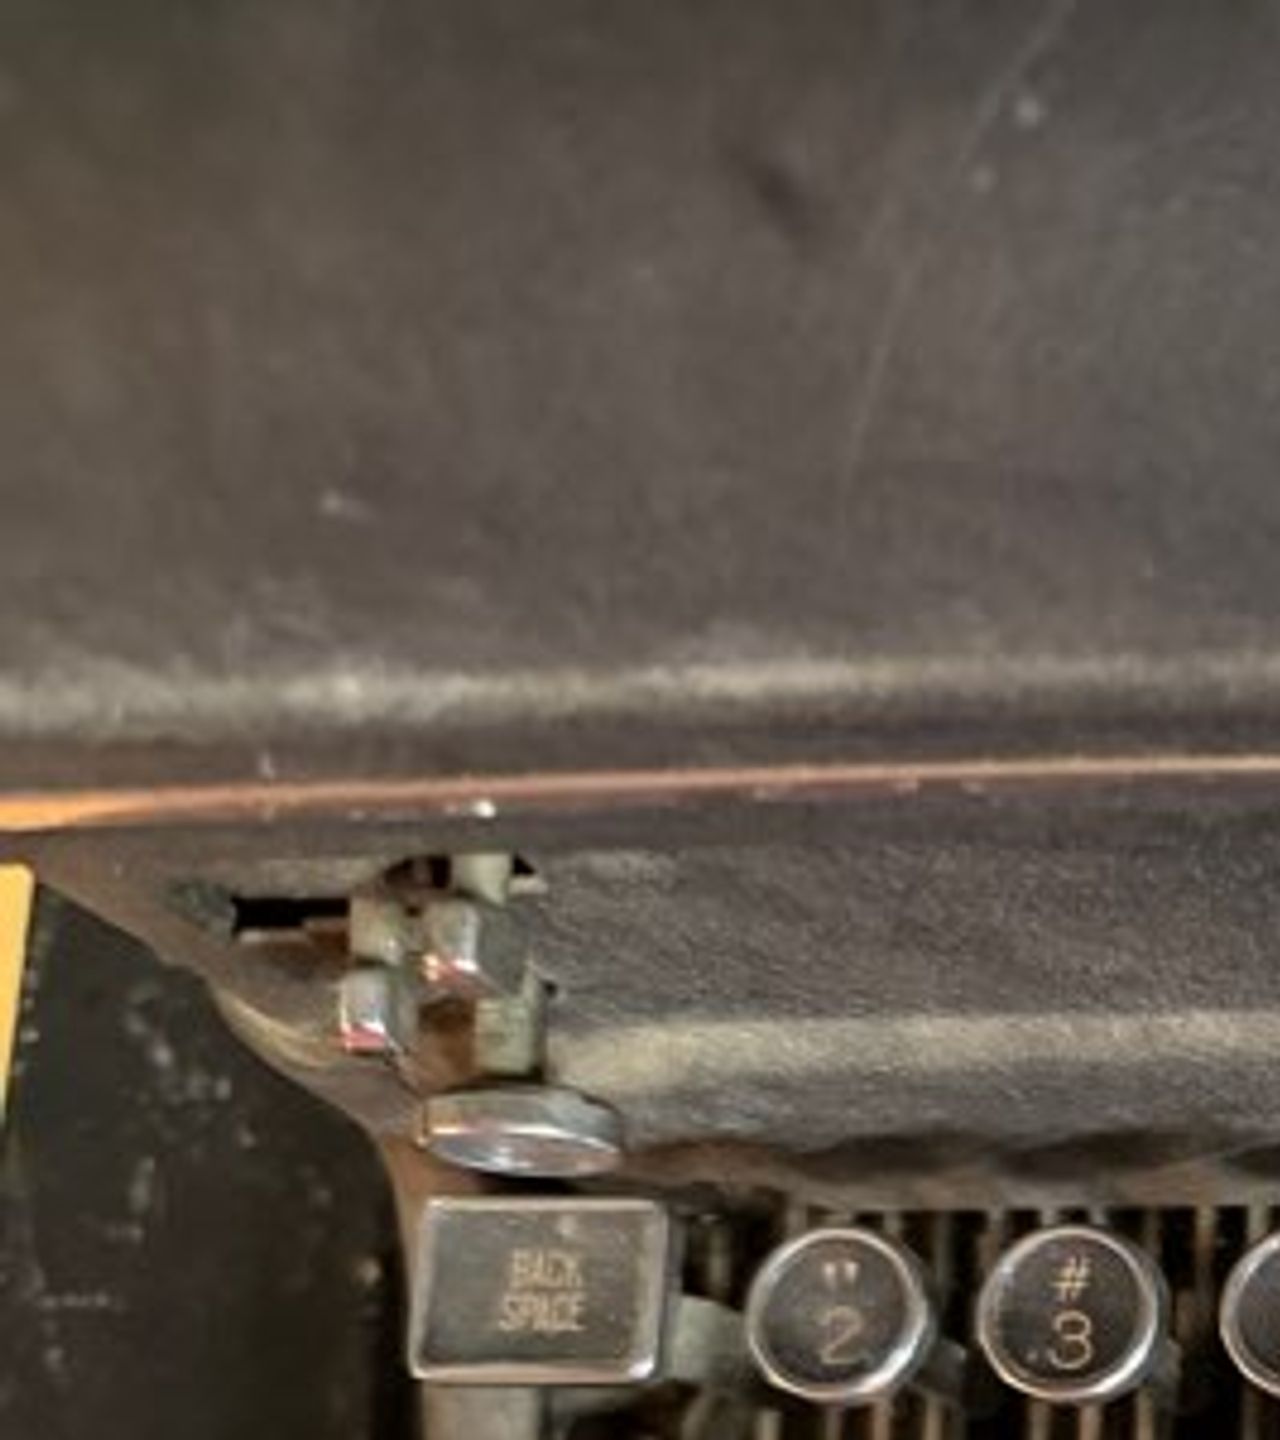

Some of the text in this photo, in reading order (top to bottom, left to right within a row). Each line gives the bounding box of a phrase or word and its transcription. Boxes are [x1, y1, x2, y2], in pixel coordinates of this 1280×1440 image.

[1052, 1256, 1090, 1301] #
[498, 1292, 587, 1331] SPACE
[817, 1304, 864, 1366] 2
[1048, 1310, 1093, 1368] 3
